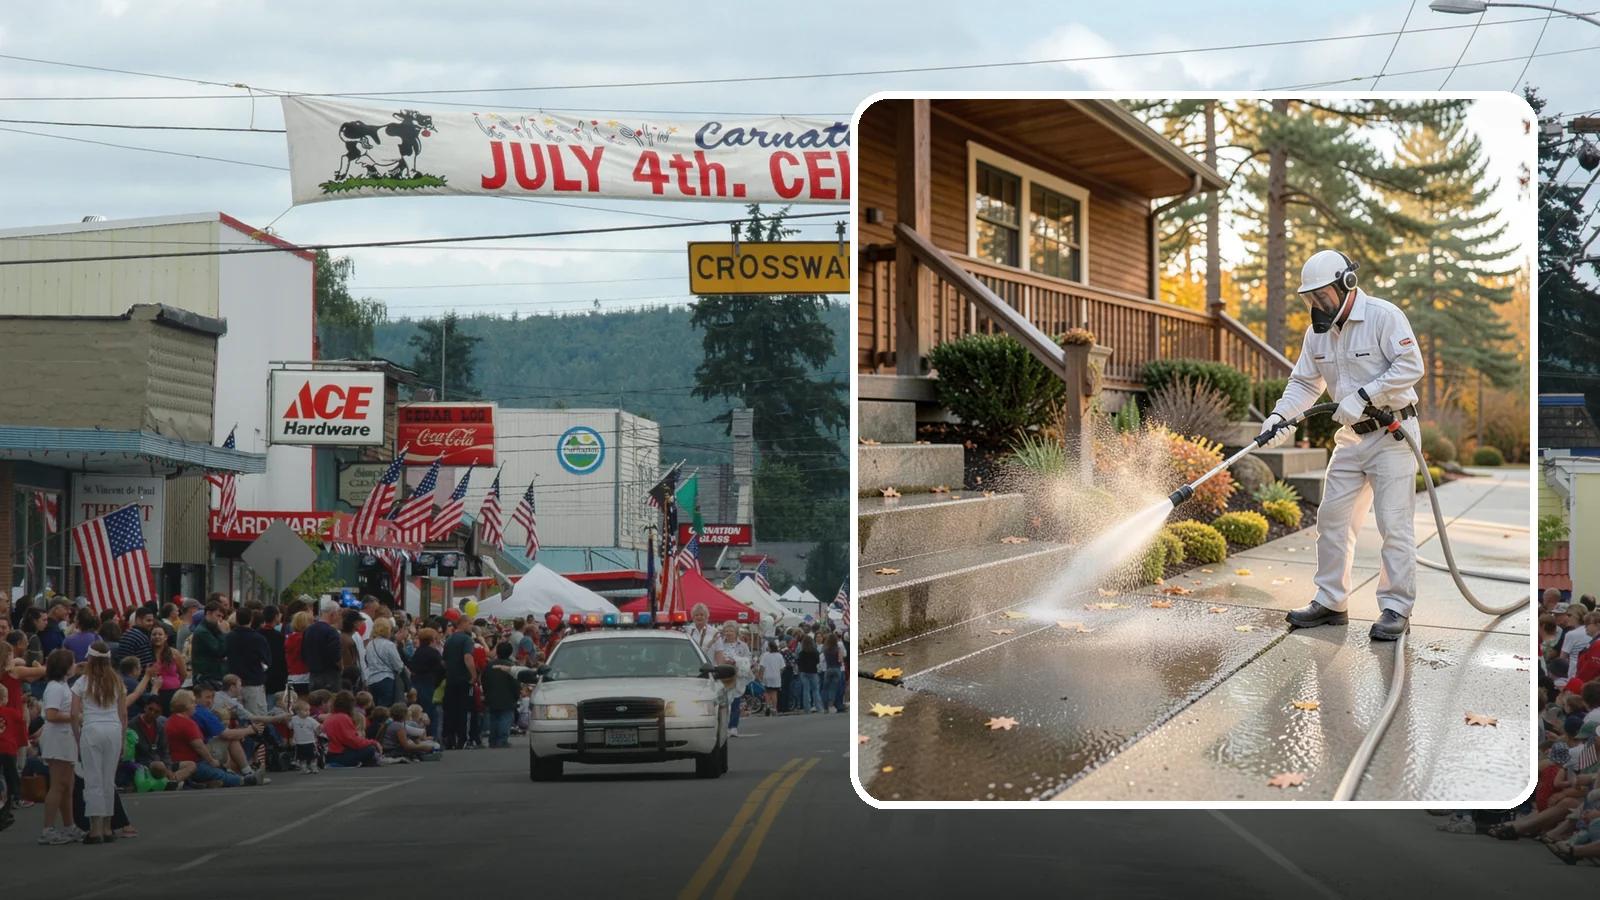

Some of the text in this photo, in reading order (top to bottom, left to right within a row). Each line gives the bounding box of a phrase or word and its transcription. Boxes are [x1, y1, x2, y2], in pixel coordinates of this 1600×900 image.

[481, 141, 605, 192] JULY
[632, 150, 746, 198] 4th.
[697, 254, 850, 280] CROSSWA
[283, 380, 373, 420] ACE
[405, 409, 485, 422] CEDAR LOG
[283, 421, 370, 437] Hardware
[416, 428, 477, 447] Coca-Cola
[354, 467, 385, 479] Simpl
[83, 485, 155, 496] St. Vincent de Paul
[81, 503, 154, 522] THT
[212, 515, 331, 535] HARDARE
[688, 526, 742, 535] CRNATION
[699, 535, 730, 543] GLASS
